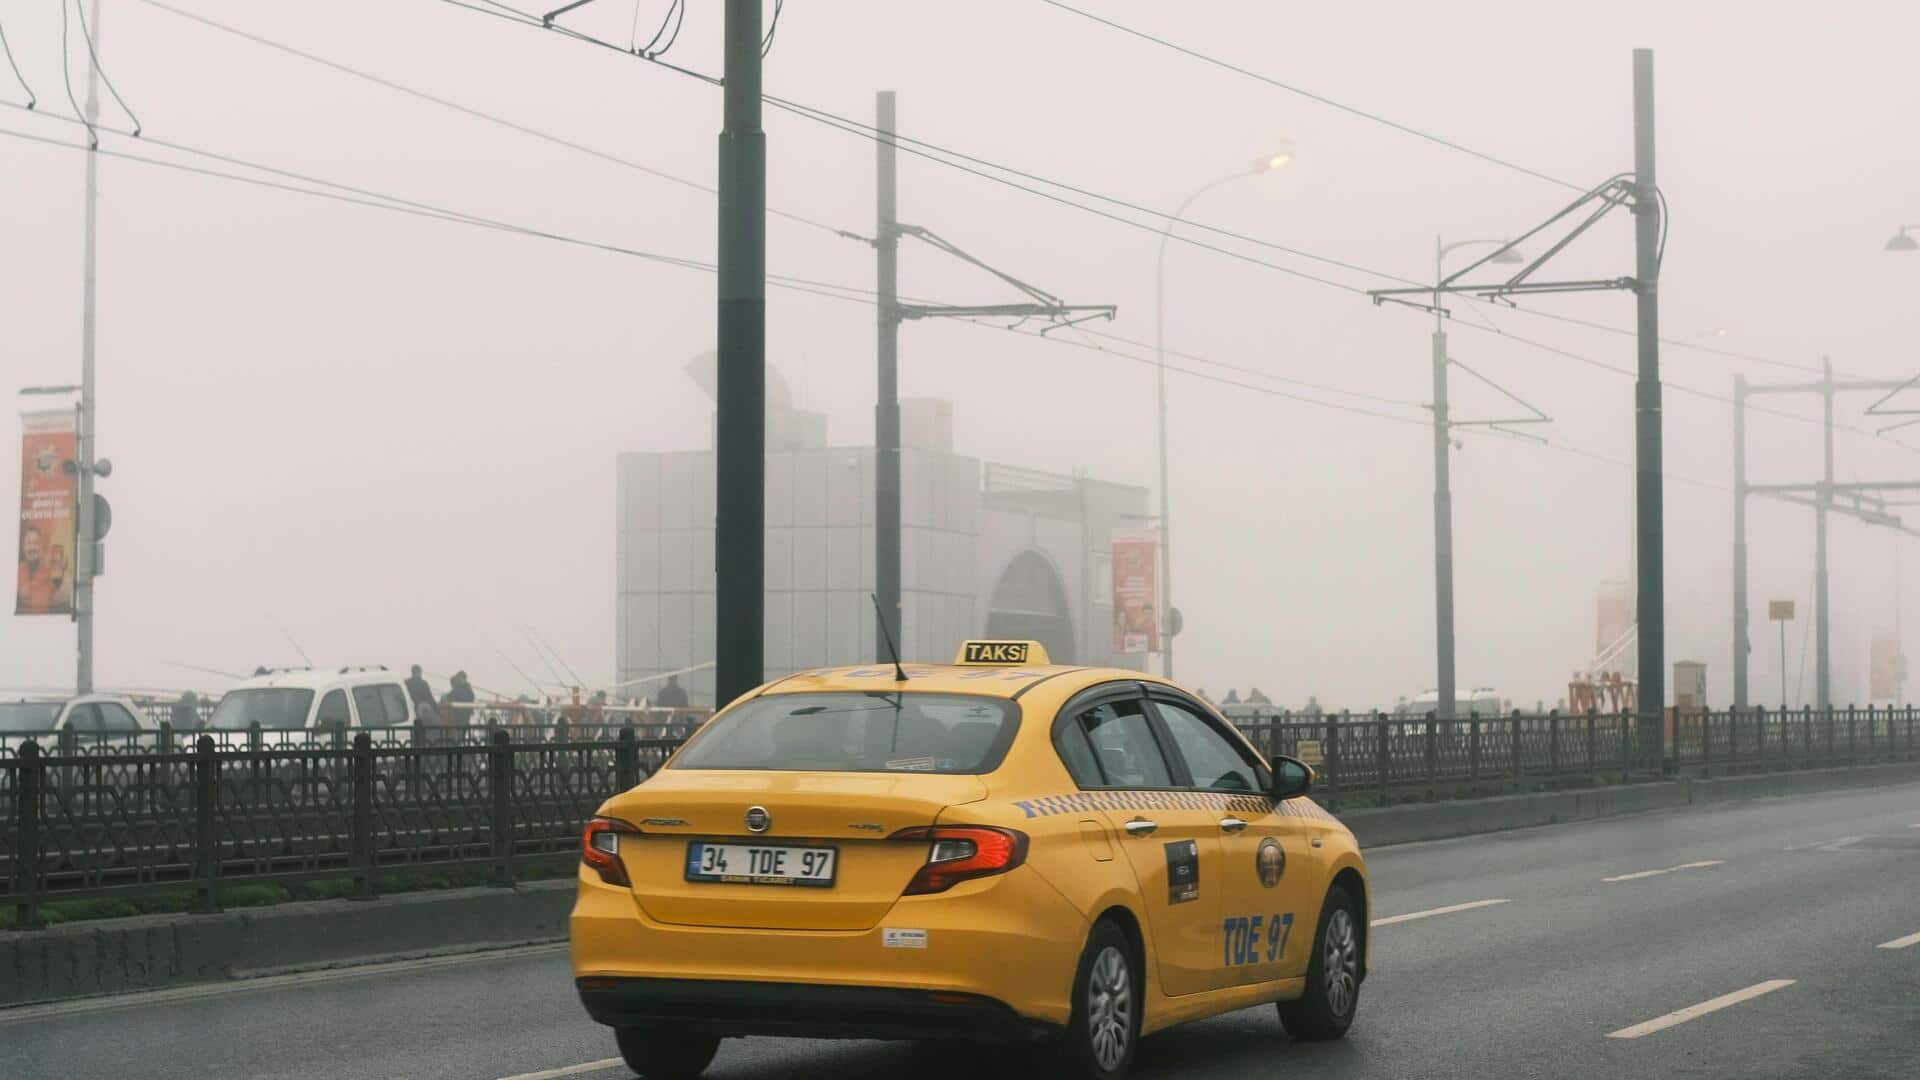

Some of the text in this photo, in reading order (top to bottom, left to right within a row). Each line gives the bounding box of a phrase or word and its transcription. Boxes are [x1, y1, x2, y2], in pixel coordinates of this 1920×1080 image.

[703, 847, 829, 877] 34 TDE 97
[1223, 912, 1294, 966] TDE 97
